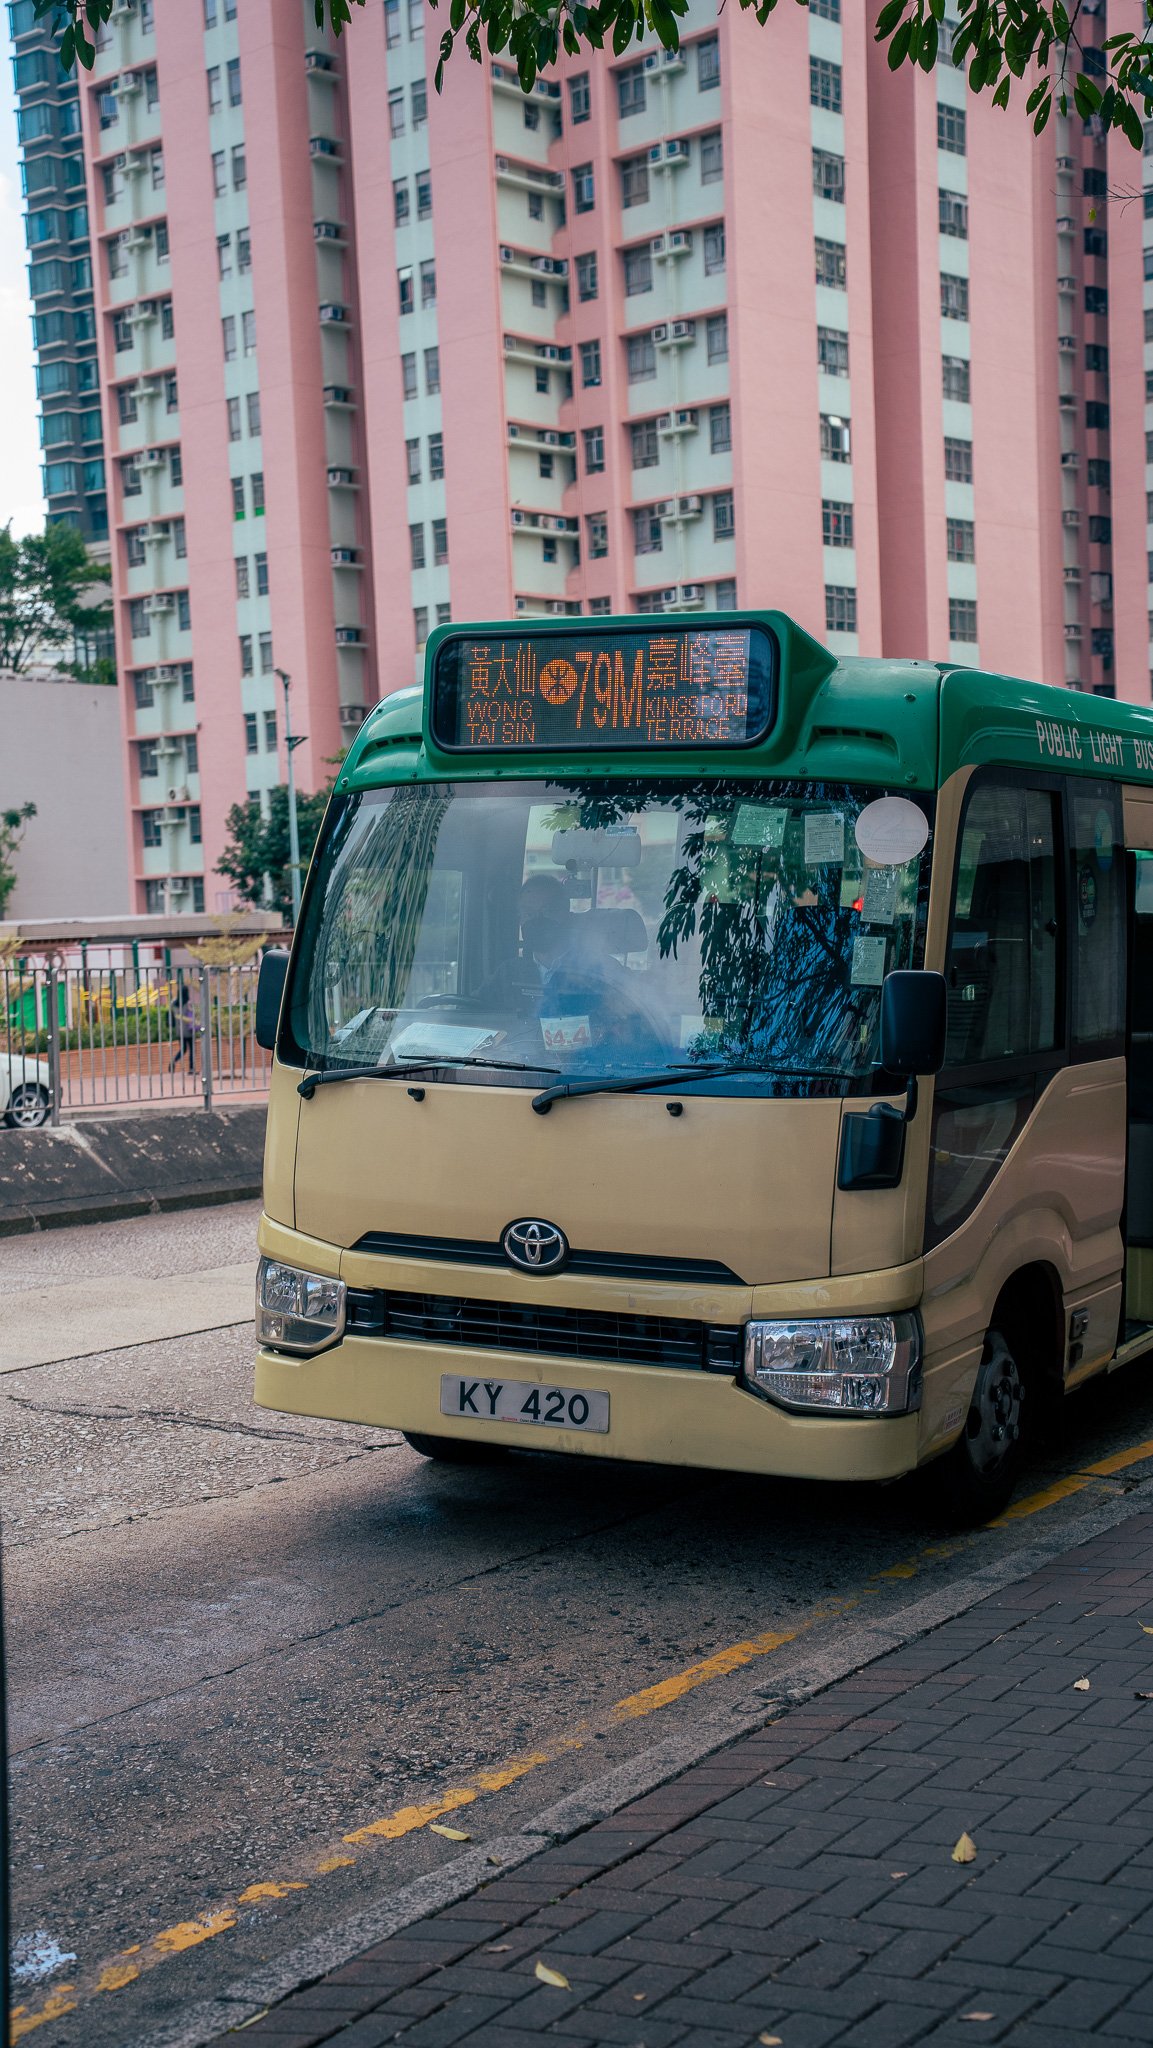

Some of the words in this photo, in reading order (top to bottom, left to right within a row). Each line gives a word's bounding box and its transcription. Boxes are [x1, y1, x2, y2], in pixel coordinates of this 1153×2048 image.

[575, 650, 644, 729] 79M
[467, 701, 533, 722] WONG
[645, 694, 748, 719] KINGSFORD
[467, 724, 496, 744] TAI
[501, 722, 536, 743] SIN
[645, 718, 731, 741] TERRACE
[1036, 720, 1082, 760] PUBLIC
[1090, 730, 1124, 767] LIGHT
[459, 1381, 503, 1415] KY
[520, 1389, 590, 1425] 420
